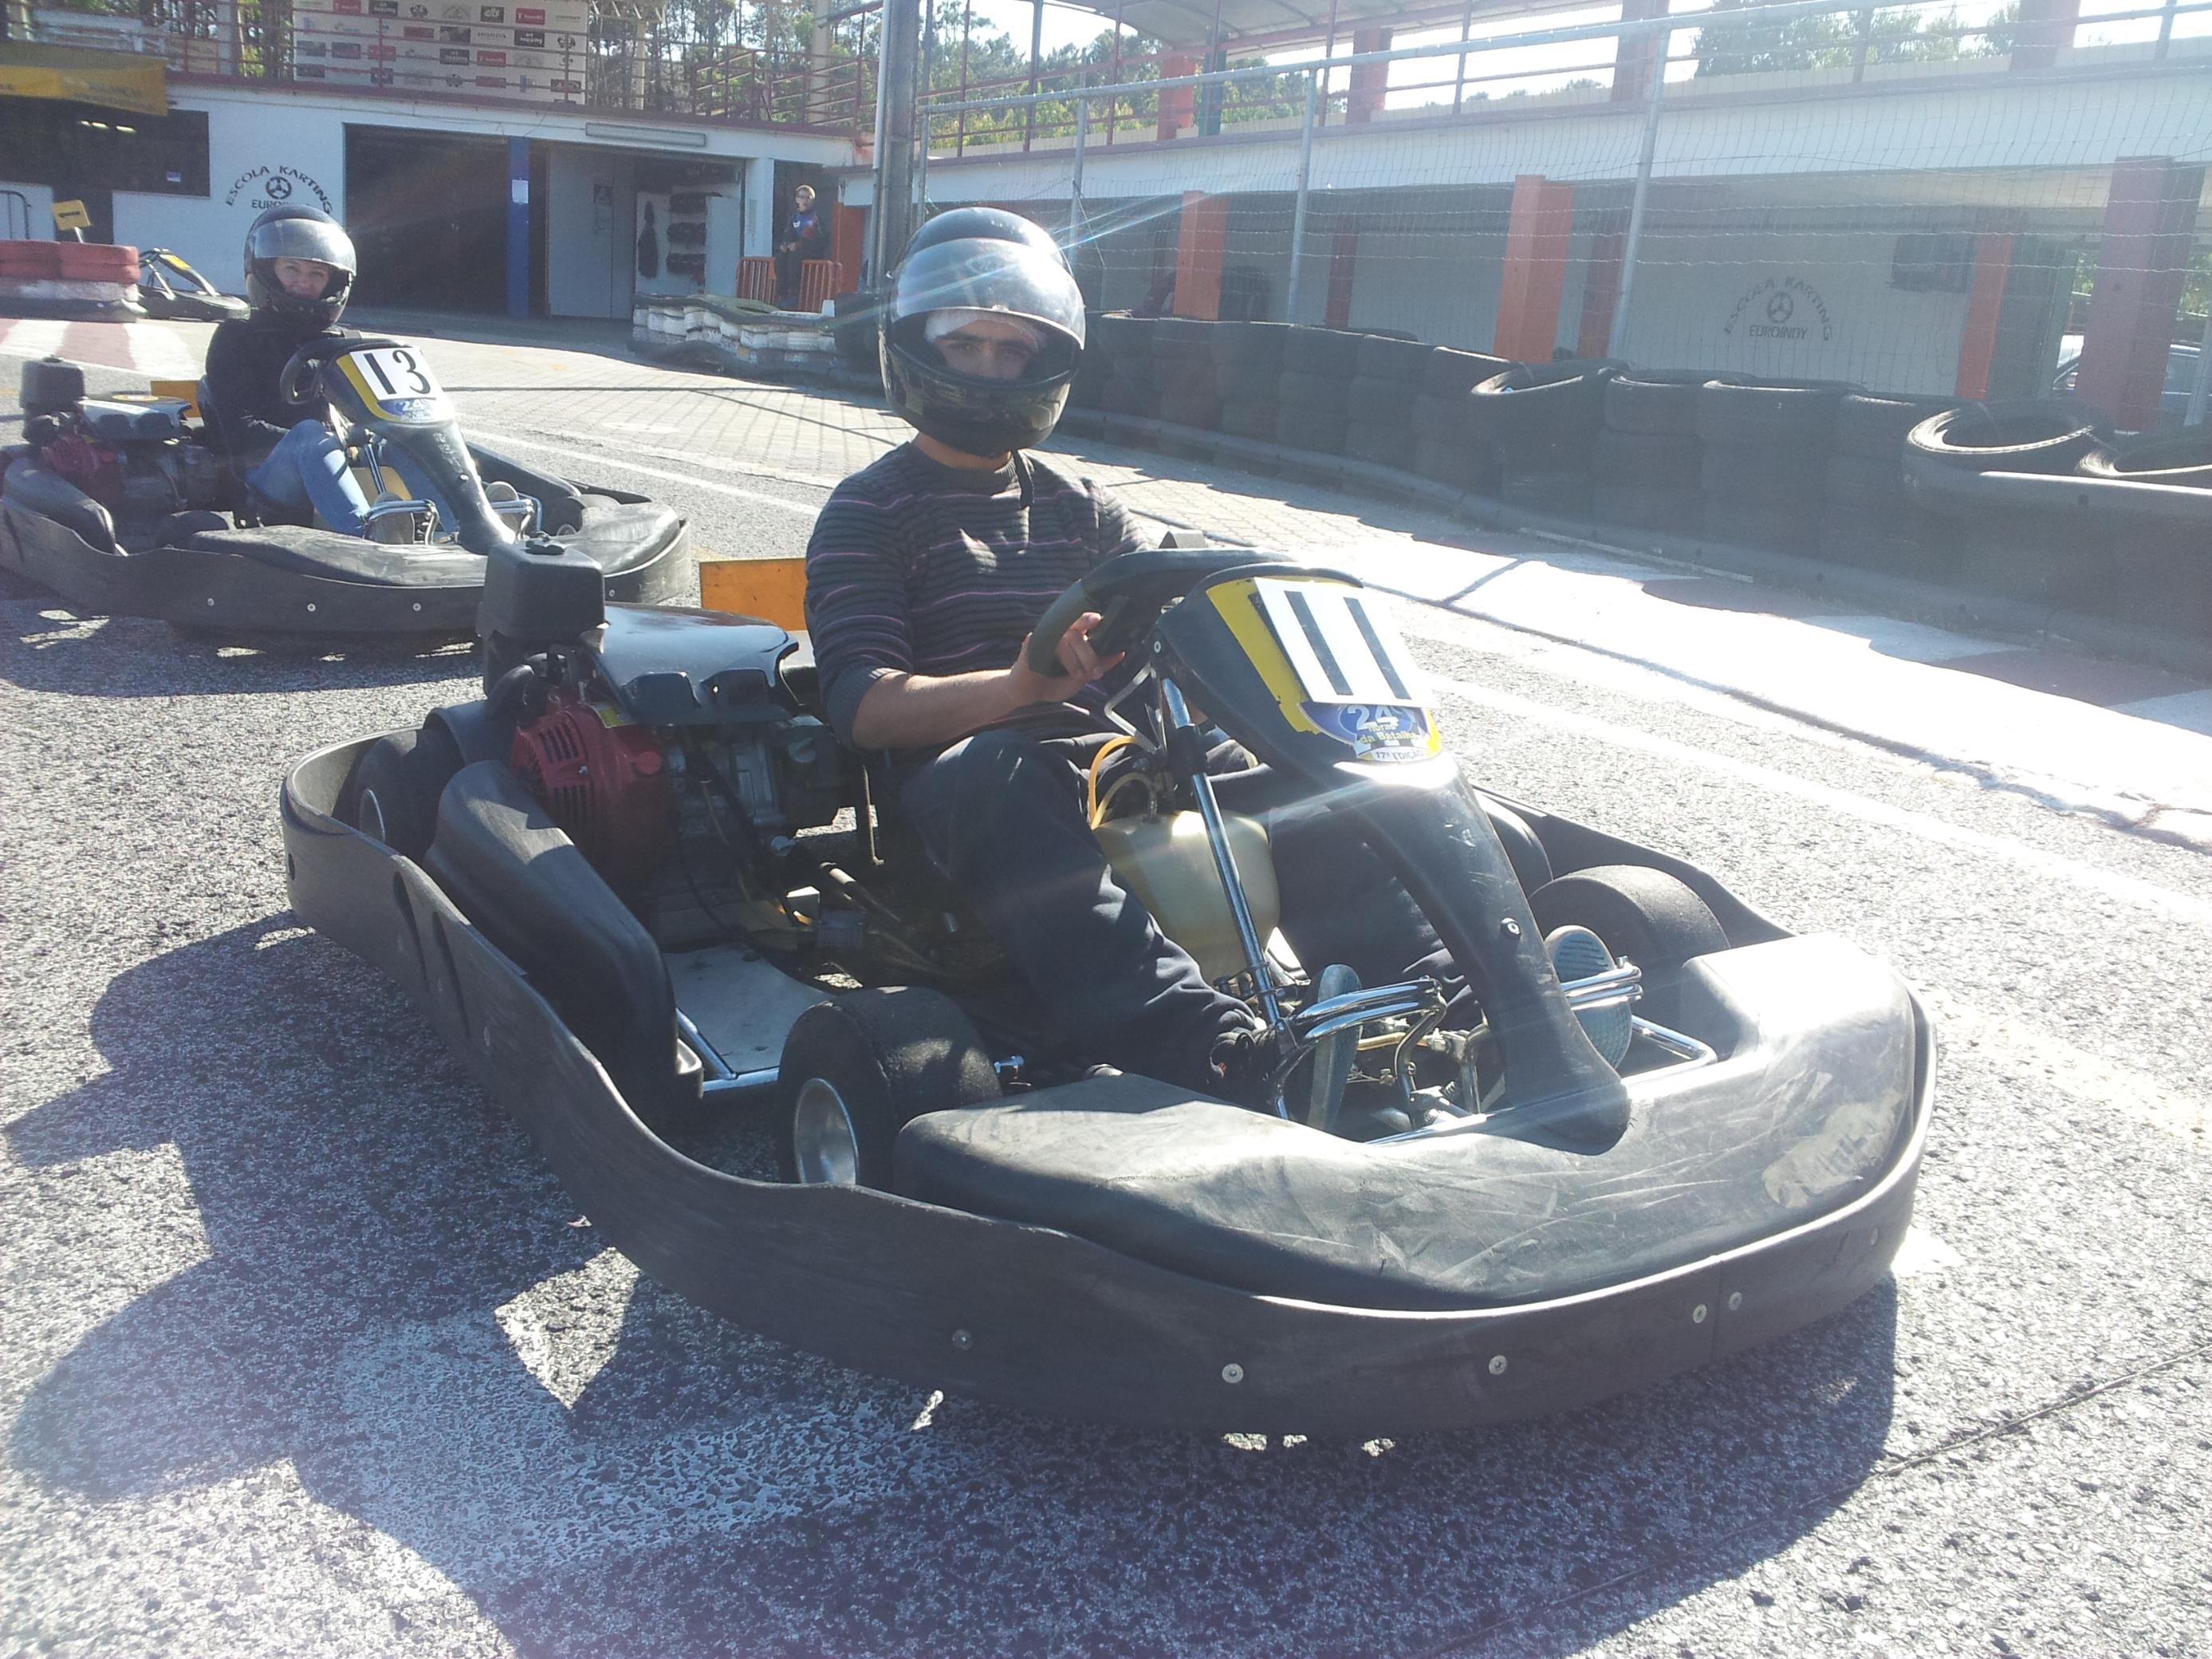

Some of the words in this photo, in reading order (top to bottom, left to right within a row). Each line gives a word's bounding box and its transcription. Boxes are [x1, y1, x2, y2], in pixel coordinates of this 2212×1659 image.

[225, 165, 270, 207] ESCOLA
[279, 165, 333, 215] KARTING
[1724, 278, 1775, 334] ESCOLA
[1785, 276, 1832, 341] KARTING
[1750, 325, 1809, 339] EUROINDY
[364, 349, 431, 395] 13
[1283, 590, 1412, 700] 11
[1360, 734, 1376, 744] da
[1376, 730, 1418, 741] Batalha
[1392, 749, 1423, 760] EDIÇÃO
